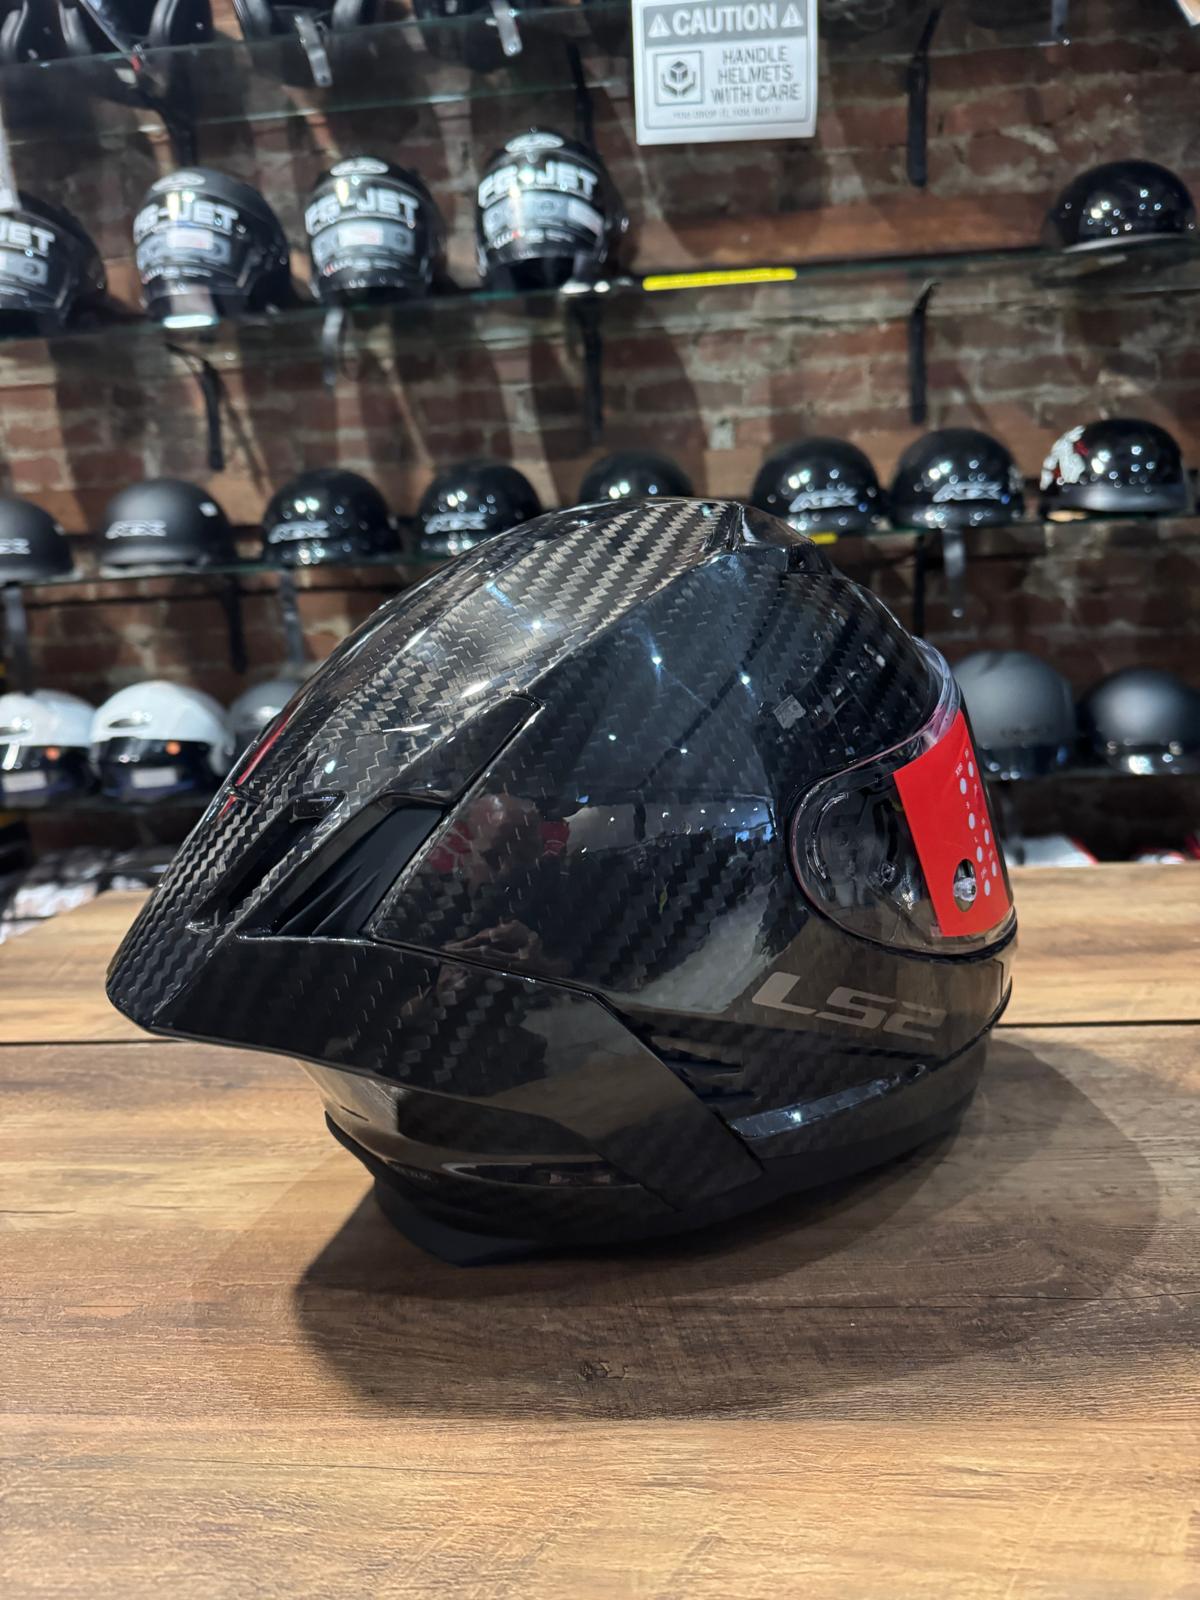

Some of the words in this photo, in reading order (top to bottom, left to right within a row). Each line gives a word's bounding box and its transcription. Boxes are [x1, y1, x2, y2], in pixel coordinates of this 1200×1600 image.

[672, 3, 778, 36] CAUTION
[722, 46, 788, 65] HANDLE
[718, 65, 793, 85] HELMETS
[711, 86, 751, 105] WITH
[755, 83, 801, 102] CARE
[752, 971, 947, 1041] LS2
